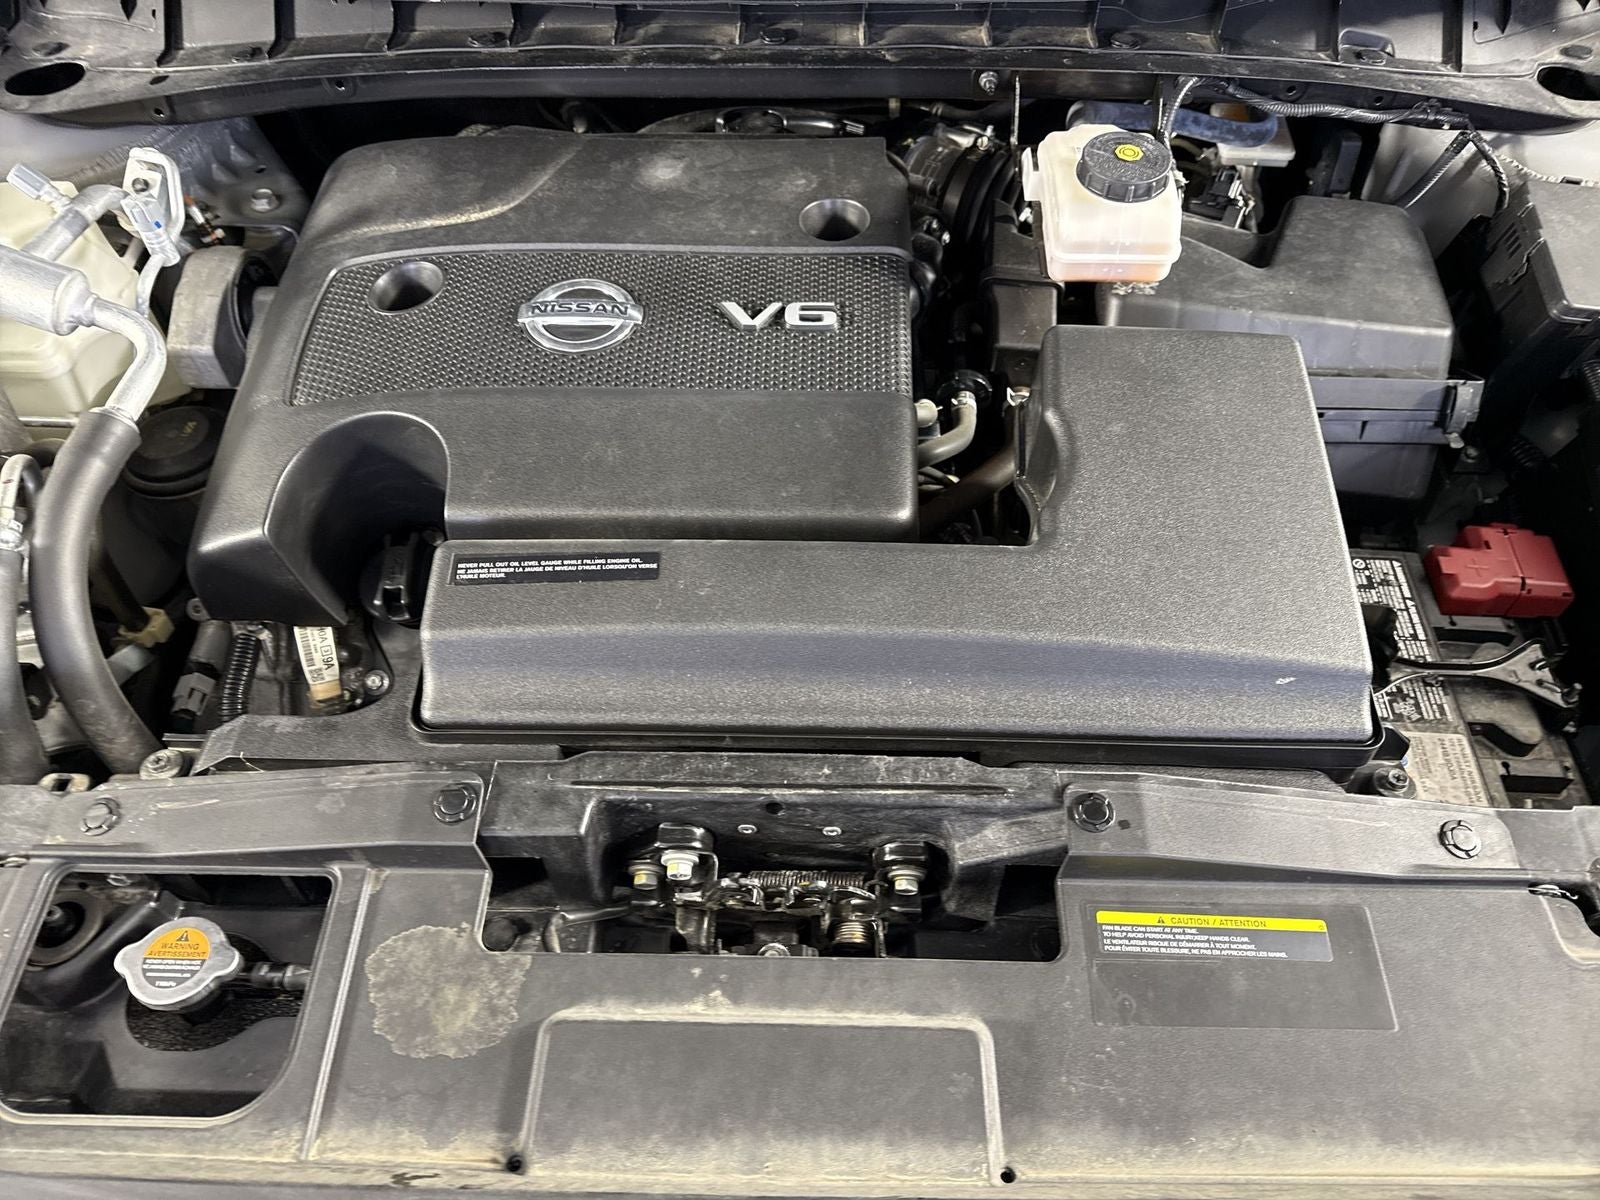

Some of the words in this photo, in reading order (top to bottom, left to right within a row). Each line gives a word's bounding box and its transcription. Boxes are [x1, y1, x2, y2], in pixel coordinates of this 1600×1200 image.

[530, 302, 629, 316] NISSAN
[719, 301, 838, 331] V6
[322, 657, 335, 671] 9A
[1170, 916, 1210, 926] CAUTION
[1219, 918, 1268, 928] ATTENTION
[160, 942, 200, 951] WARNING
[148, 950, 207, 958] AVERTISSEMENT
